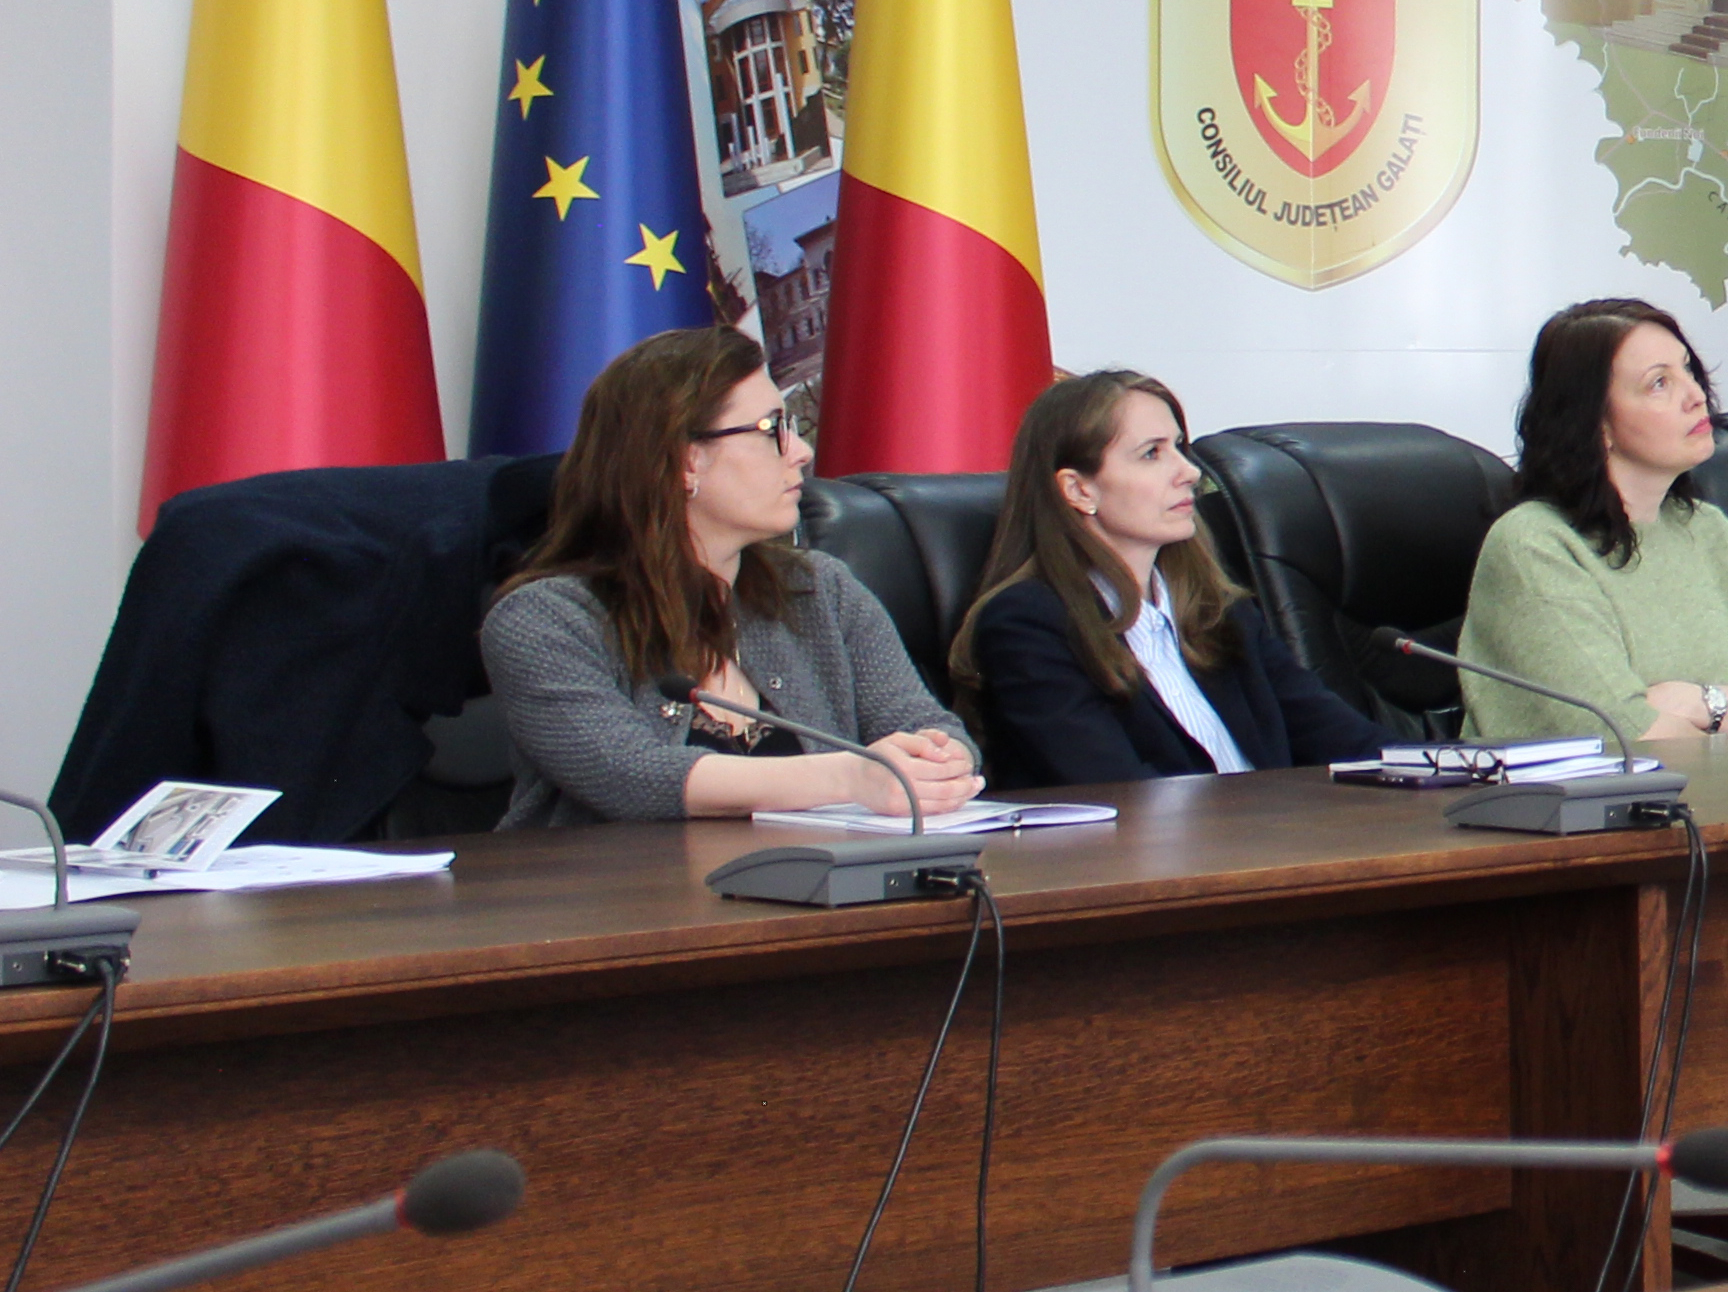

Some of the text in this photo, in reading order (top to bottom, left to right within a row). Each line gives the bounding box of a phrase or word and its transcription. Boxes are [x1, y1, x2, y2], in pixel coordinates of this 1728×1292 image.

[1197, 107, 1427, 231] CONSILIUL JUDEȚEAN GALAȚI
